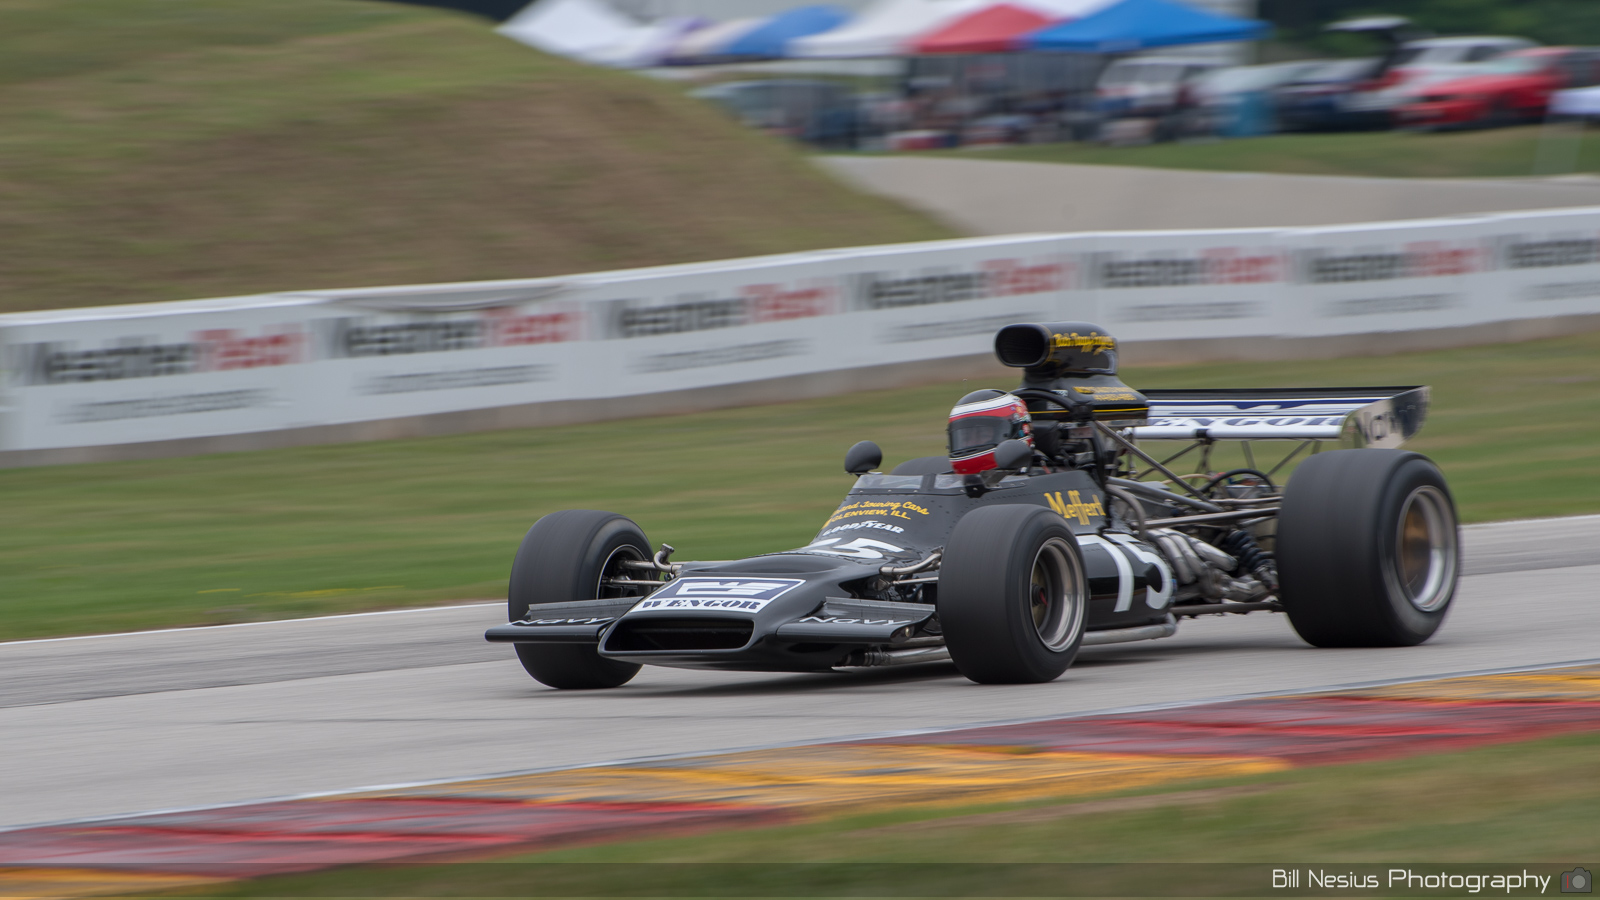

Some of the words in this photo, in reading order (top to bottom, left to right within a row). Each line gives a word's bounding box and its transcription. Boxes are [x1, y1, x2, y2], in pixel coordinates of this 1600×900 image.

[1147, 417, 1344, 427] ENGOR
[860, 500, 902, 511] Touring
[902, 501, 930, 515] Cars
[890, 509, 912, 521] ILL.
[1043, 489, 1107, 526] Meffert
[822, 520, 905, 535] GOODYEAR
[1076, 533, 1173, 613] 75
[641, 599, 762, 610] WENGOR
